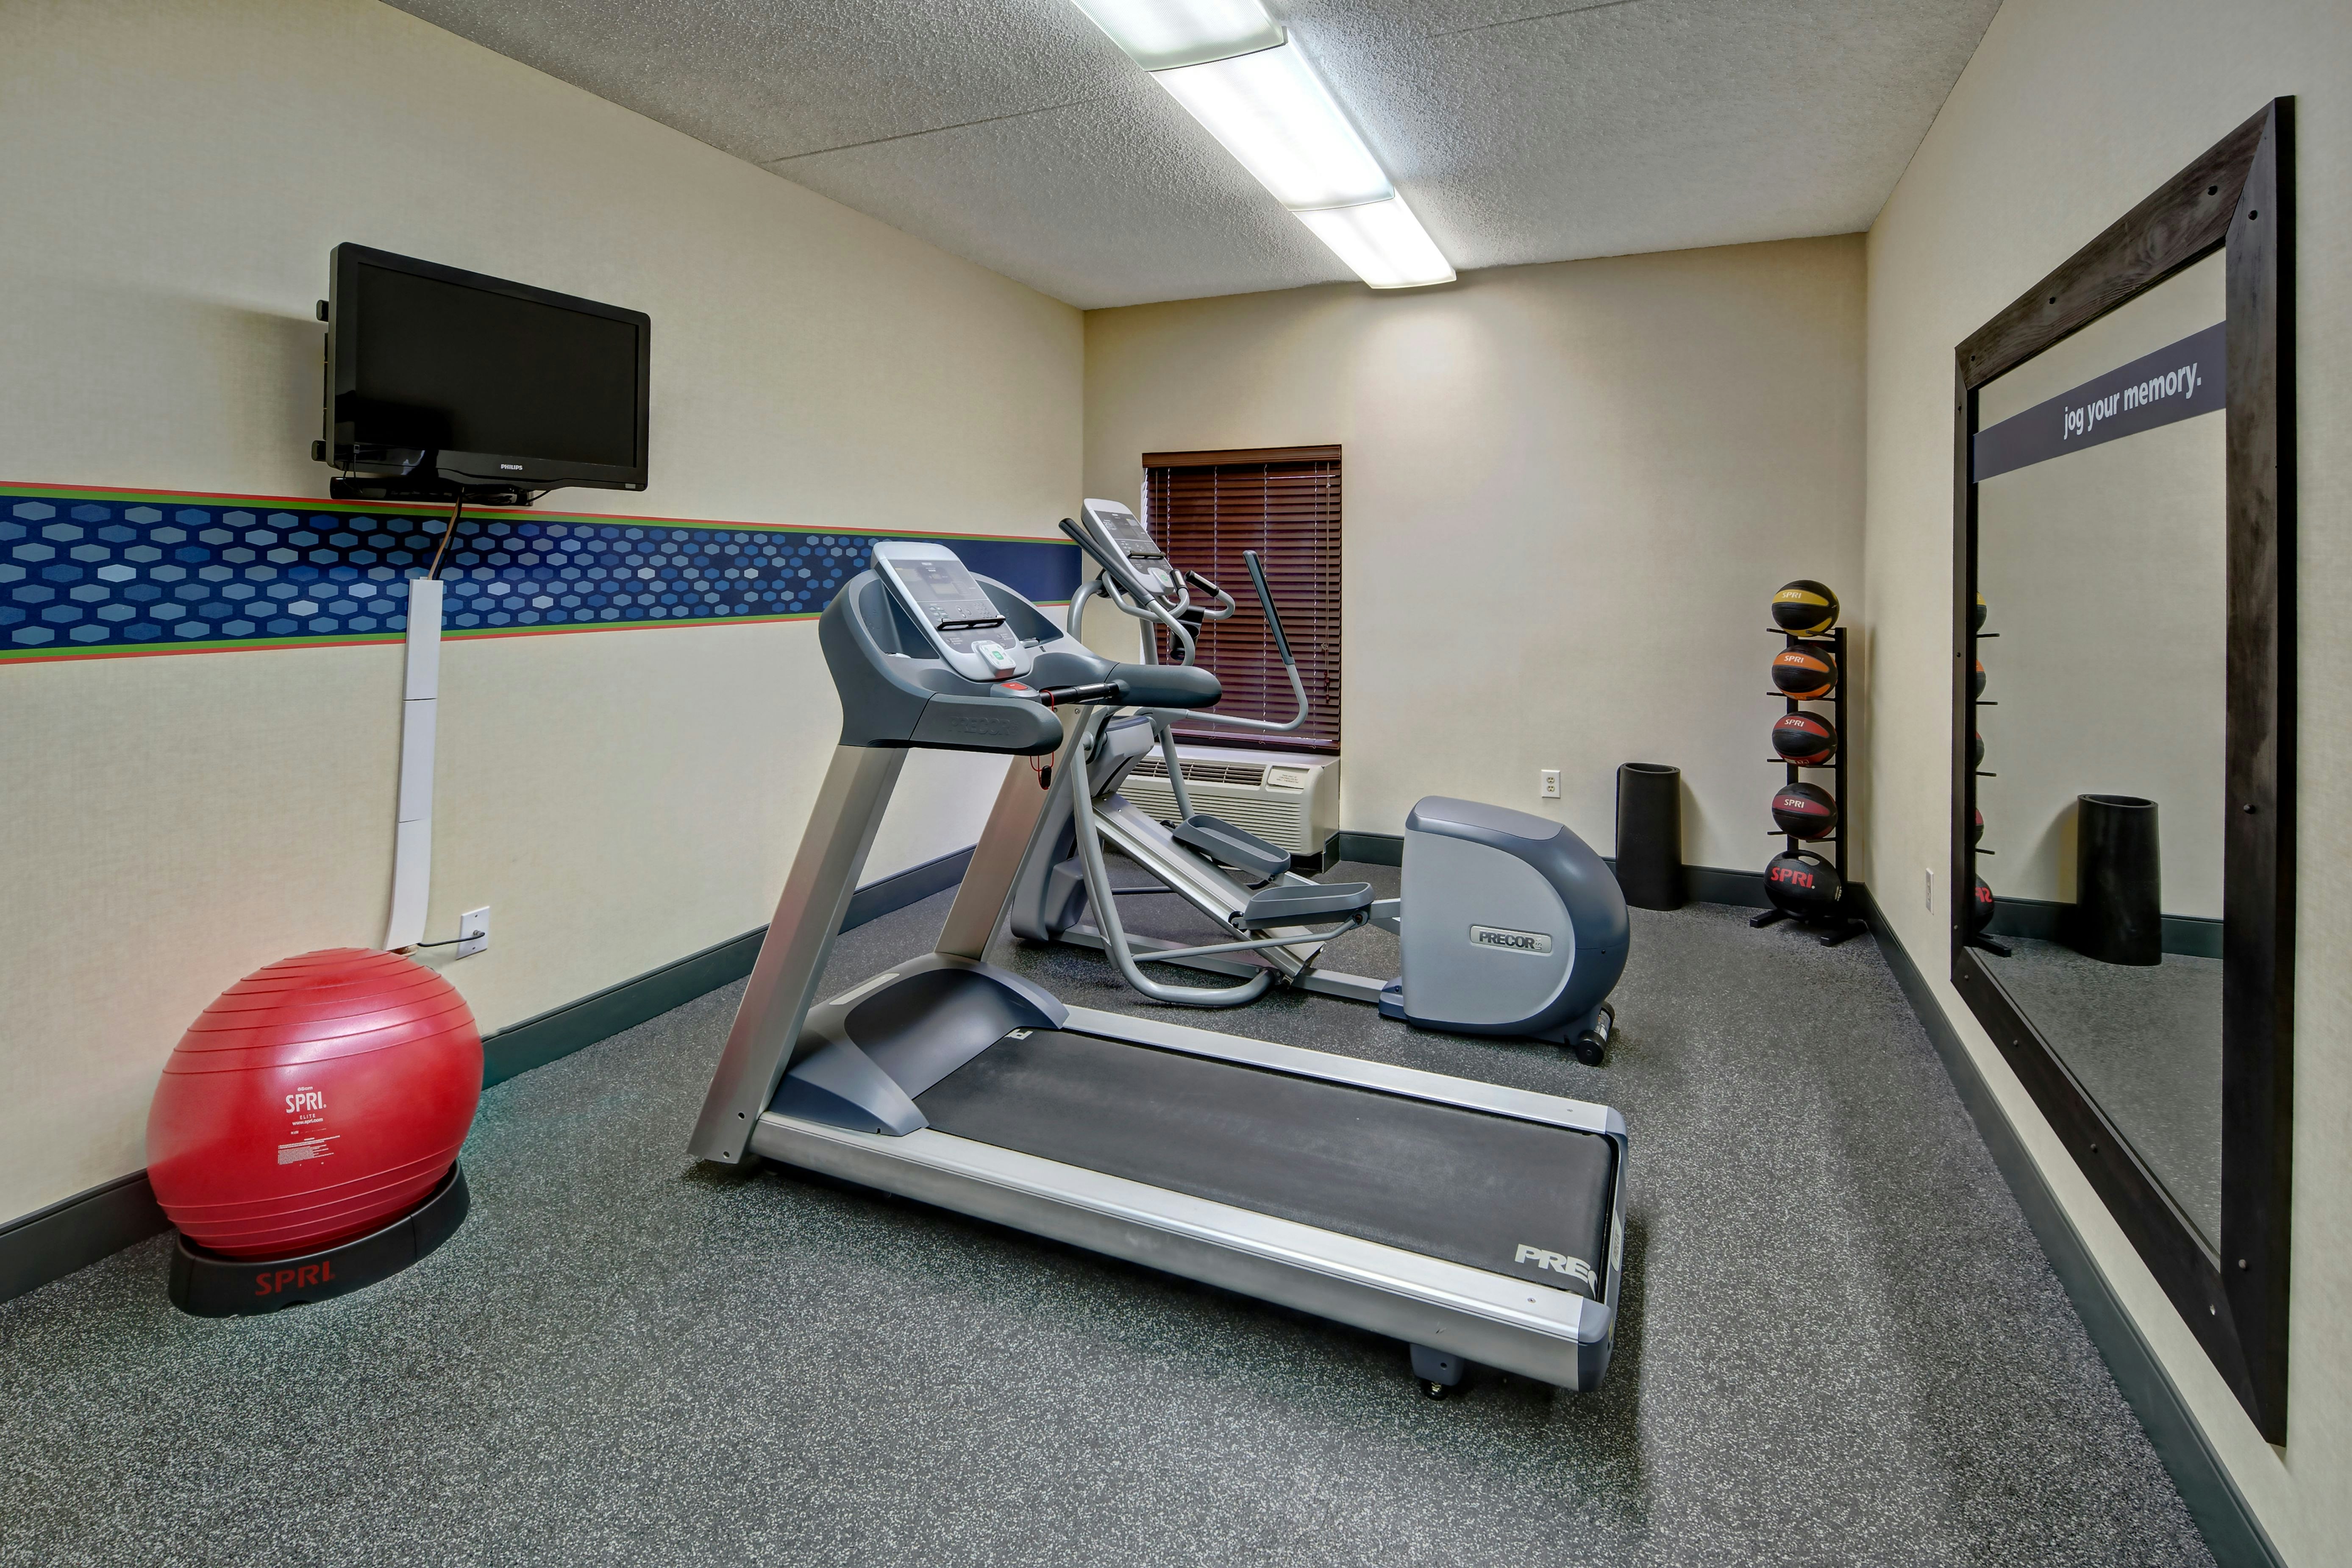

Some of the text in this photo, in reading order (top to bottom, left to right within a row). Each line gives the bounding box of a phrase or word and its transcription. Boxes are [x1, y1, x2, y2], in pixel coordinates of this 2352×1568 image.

[2064, 362, 2202, 440] jog your memory.
[1784, 655, 1804, 663] SPRI
[1784, 799, 1804, 808] SPRI
[1479, 931, 1535, 950] PRECOR
[292, 1118, 323, 1126] www.spri.com
[255, 1261, 330, 1296] SPRI
